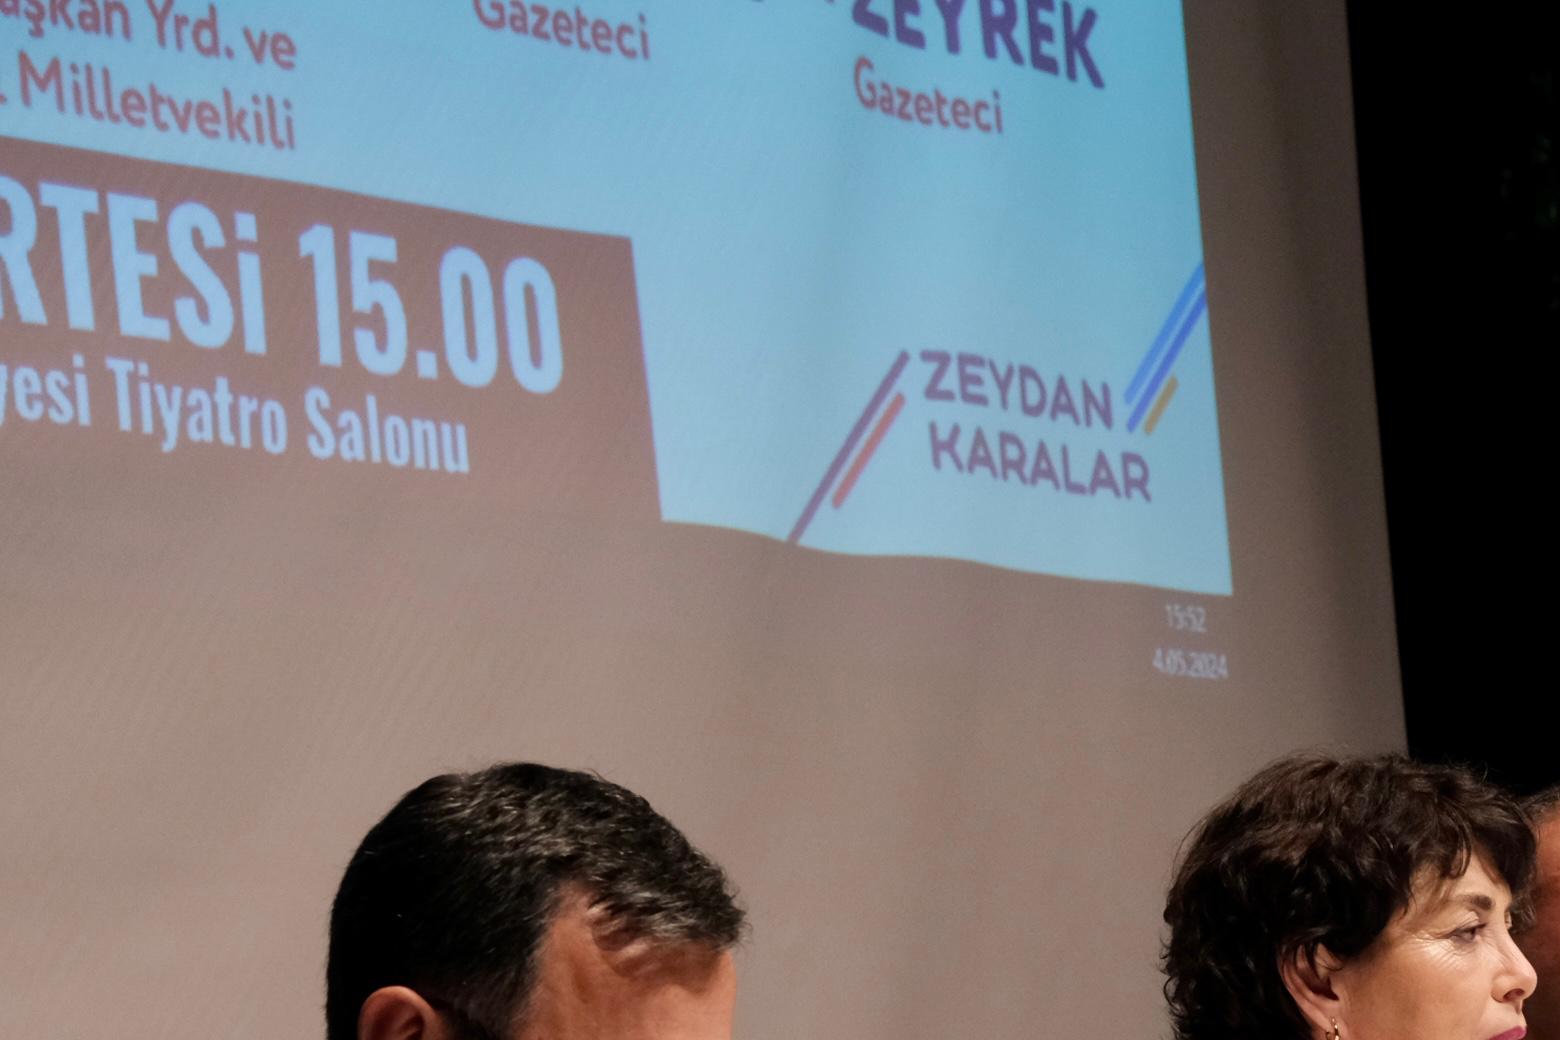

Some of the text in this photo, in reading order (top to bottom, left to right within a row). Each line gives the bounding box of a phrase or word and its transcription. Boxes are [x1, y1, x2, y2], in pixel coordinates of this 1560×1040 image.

[146, 0, 235, 59] Yrd.
[243, 26, 297, 71] ve
[472, 0, 650, 60] Gazeteci
[18, 49, 296, 150] Milletvekili
[853, 56, 1003, 134] Gazeteci
[299, 222, 563, 395] 15.00
[0, 353, 470, 474] esi Tiyatro Salonu
[919, 350, 1113, 430] ZEYDAN
[928, 420, 1152, 502] KARALAR
